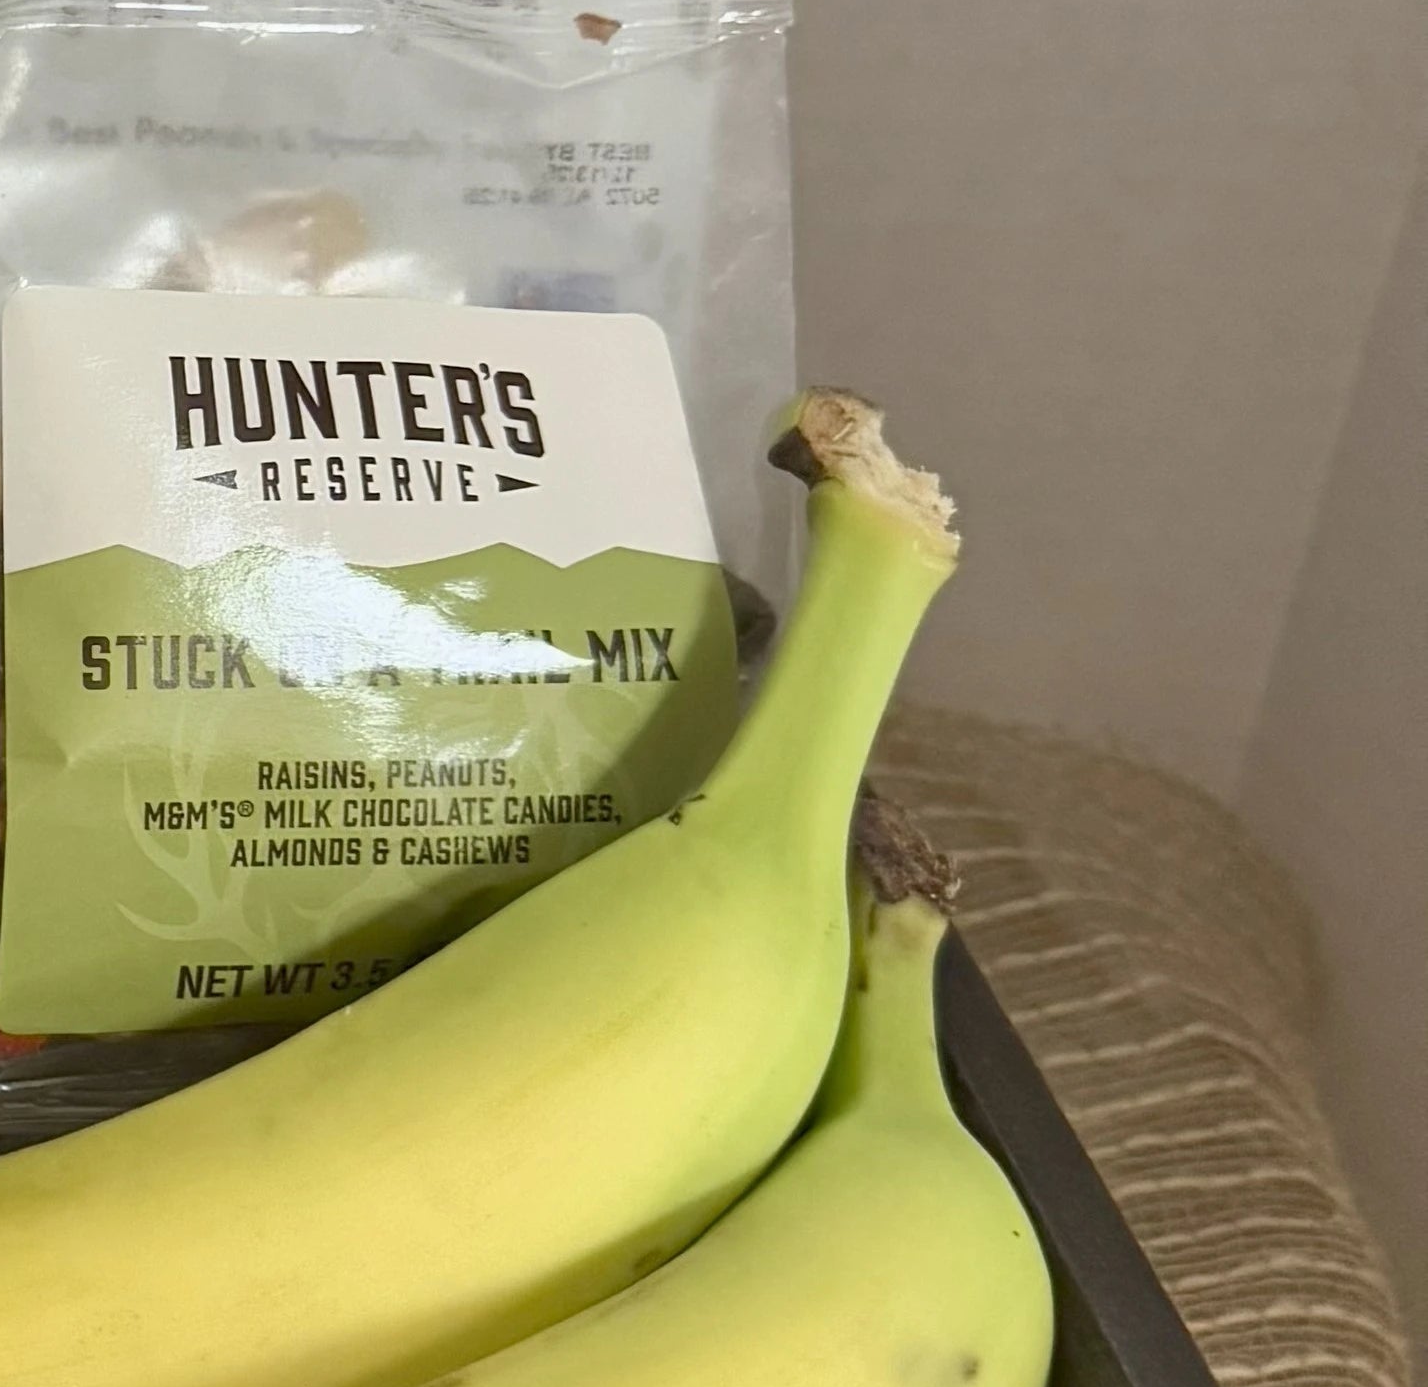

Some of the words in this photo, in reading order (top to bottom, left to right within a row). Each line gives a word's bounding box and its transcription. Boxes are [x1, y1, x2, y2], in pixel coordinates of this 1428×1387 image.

[169, 355, 545, 458] HUNTER'S
[261, 458, 481, 502] RESERVE
[81, 633, 256, 691] STUCK
[585, 626, 680, 684] MIX
[257, 760, 377, 792] RAISINS,
[386, 758, 516, 790] PEANUTS,
[265, 798, 332, 830] MILK
[342, 796, 494, 828] CHOCOLATE
[503, 793, 623, 827] CANDIES,
[230, 837, 362, 868] ALMONDS
[372, 837, 390, 866] &
[400, 834, 531, 866] CASHEWS
[175, 963, 253, 1000] NET
[263, 960, 326, 996] WT
